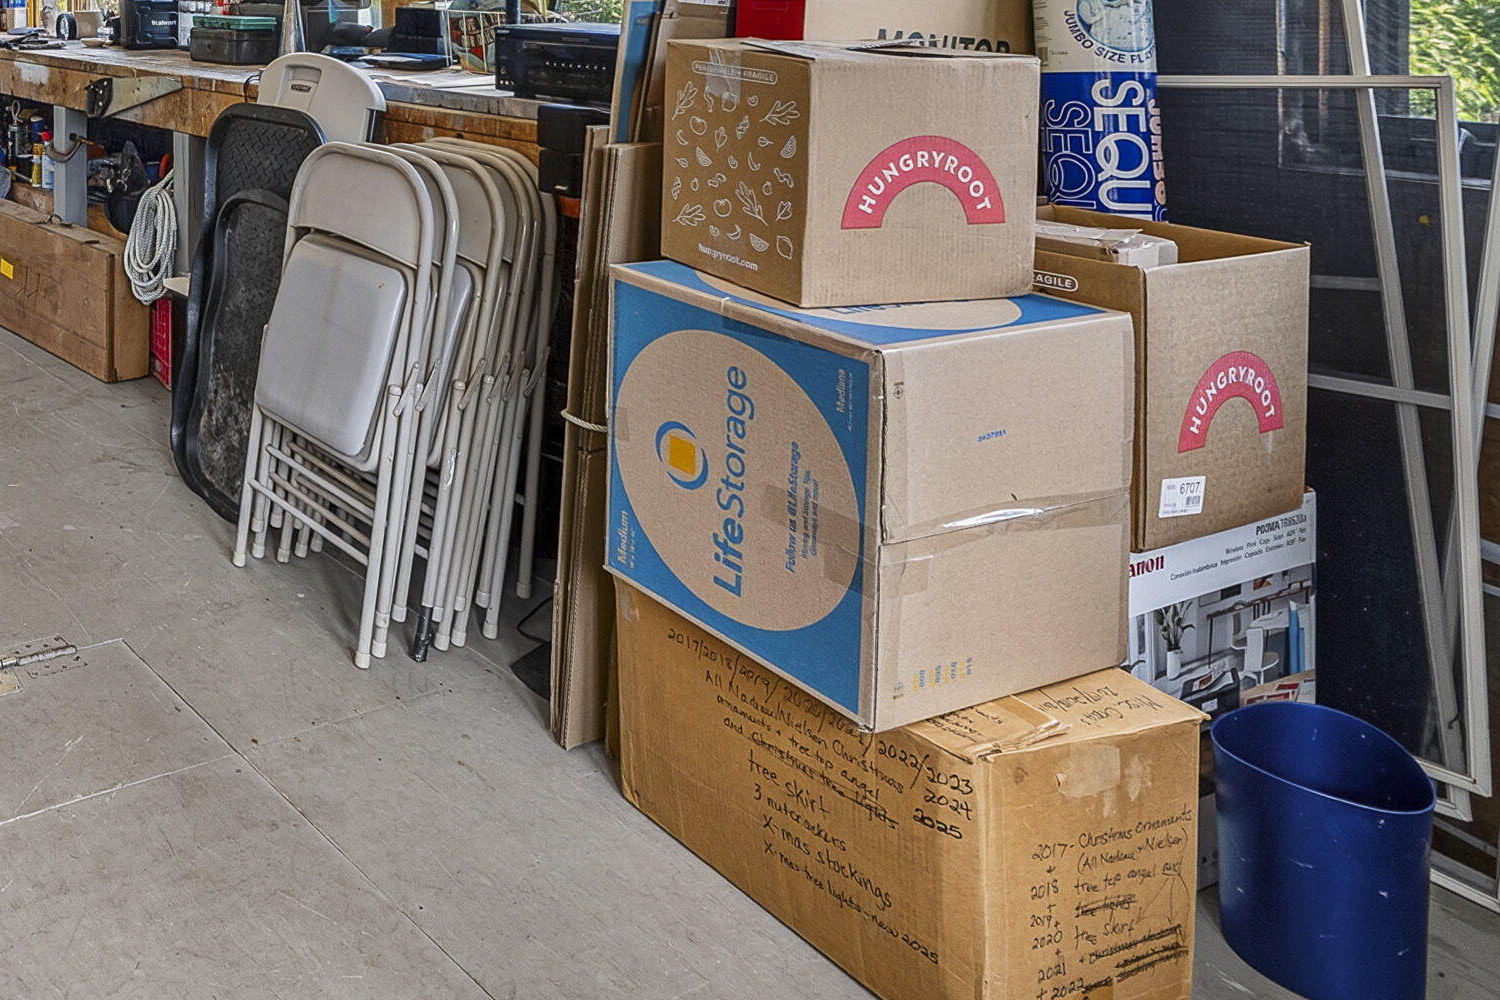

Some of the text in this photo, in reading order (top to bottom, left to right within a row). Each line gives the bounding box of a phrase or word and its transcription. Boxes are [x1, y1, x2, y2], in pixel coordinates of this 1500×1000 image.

[1064, 10, 1094, 49] JUMBO
[1094, 46, 1126, 64] SIZE
[743, 69, 775, 82] FRAGILE
[1091, 79, 1153, 220] SEQU
[858, 150, 991, 214] HUNGRYROOT
[698, 242, 758, 272] hungryroot.com
[1035, 274, 1073, 289] AGILE
[1189, 366, 1275, 434] HUNGRYROOT
[712, 366, 755, 598] LifeStorage
[1179, 481, 1201, 496] 6707
[616, 510, 629, 564] Medium
[787, 518, 797, 532] us
[1256, 520, 1280, 536] PIXMA
[785, 534, 797, 574] Follow
[1129, 554, 1165, 580] anon
[705, 670, 722, 689] All
[832, 738, 904, 794] Christmas
[724, 717, 743, 736] and
[716, 694, 772, 732] ornaments
[789, 736, 812, 757] tree
[815, 750, 834, 770] top
[840, 768, 880, 801] angel
[748, 749, 831, 821] tree skirt
[753, 783, 763, 801] 3
[924, 788, 973, 821] 2024
[913, 807, 963, 840] 2025
[1078, 826, 1133, 850] Christmas
[816, 849, 893, 911] stockings
[1031, 879, 1059, 901] 2018
[1074, 877, 1100, 896] tree
[1102, 871, 1122, 889] top
[1127, 864, 1157, 886] angel
[1030, 914, 1053, 929] 2019
[1032, 914, 1135, 951] 2020 tree skirt
[901, 934, 939, 965] 2025
[1037, 961, 1067, 984] 2021
[1050, 976, 1086, 1000] 2022
